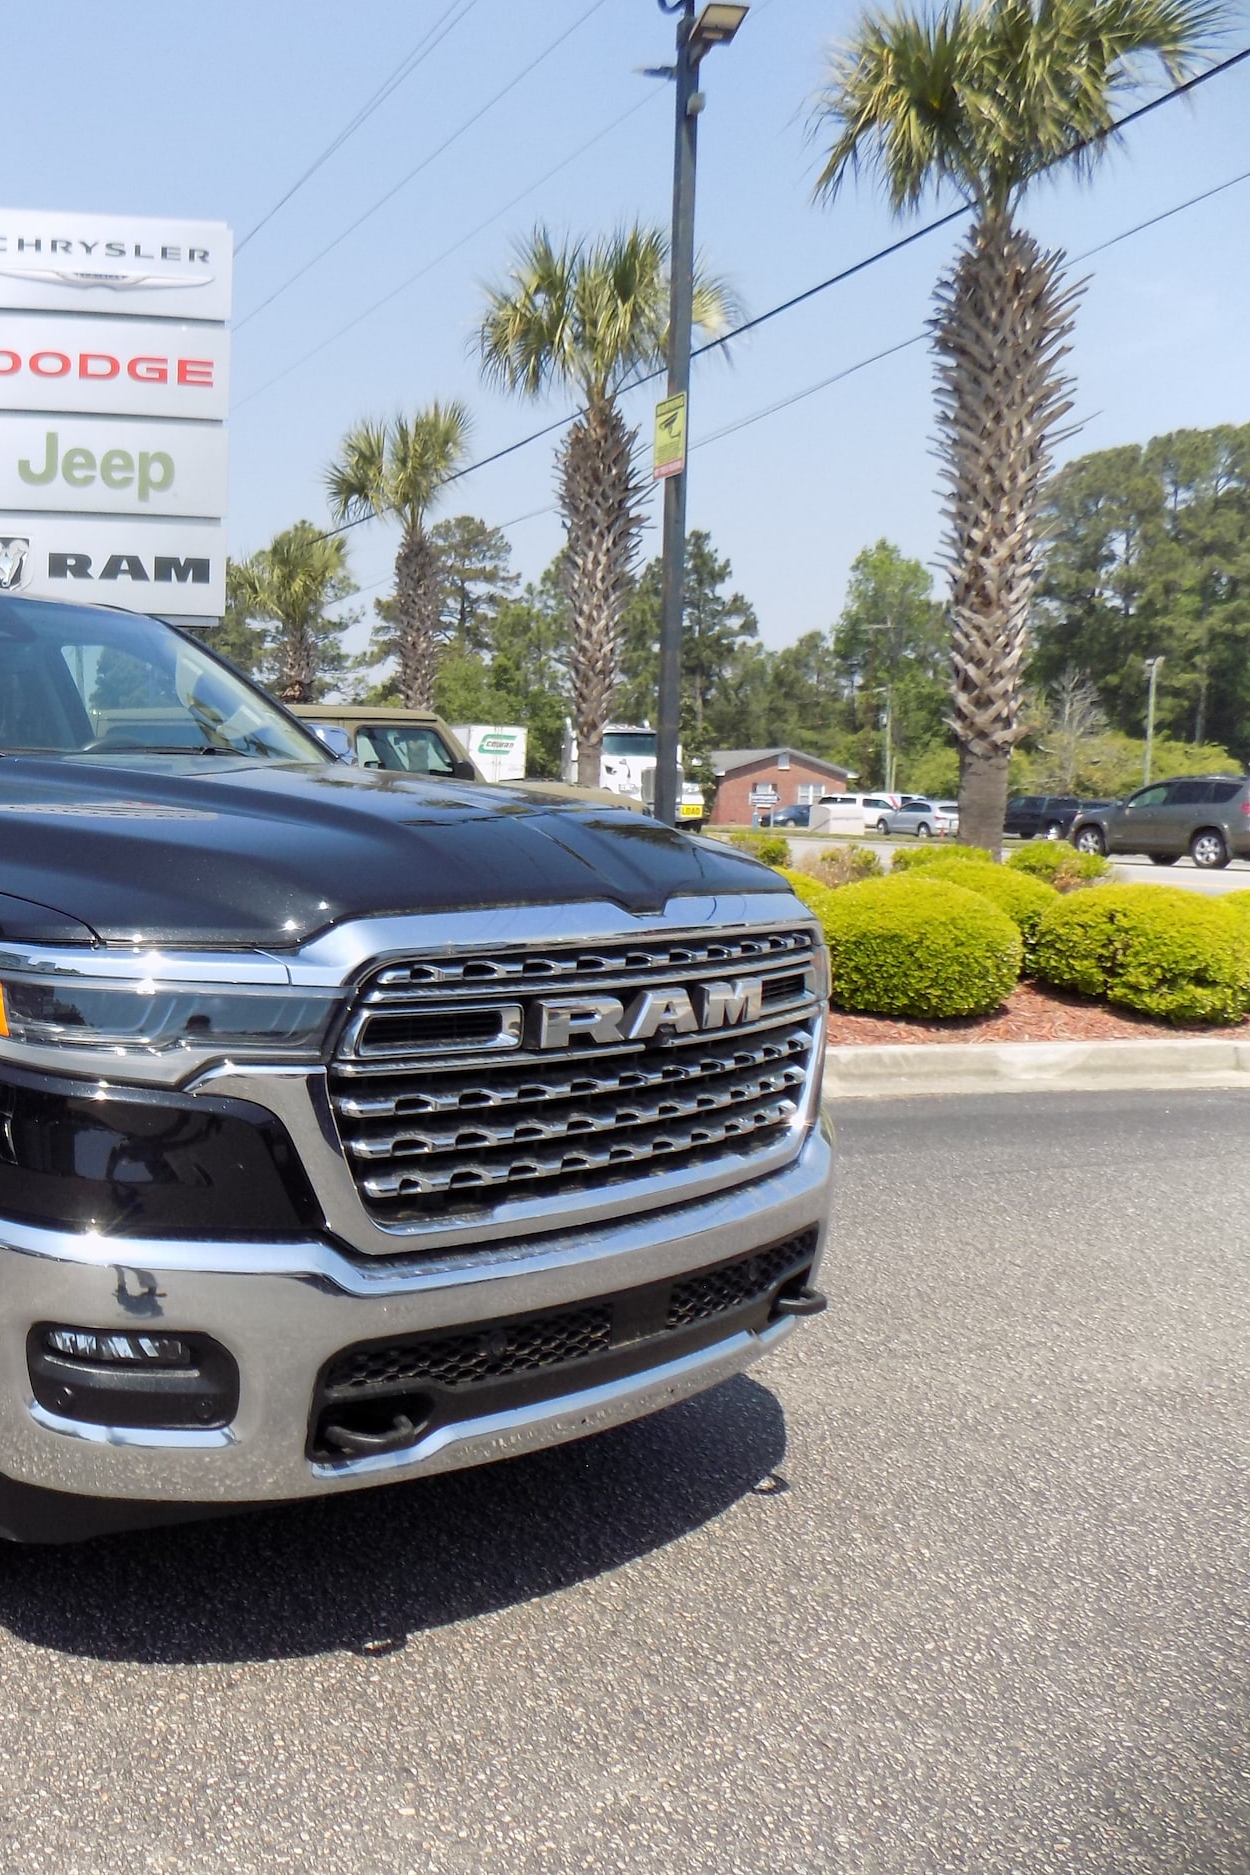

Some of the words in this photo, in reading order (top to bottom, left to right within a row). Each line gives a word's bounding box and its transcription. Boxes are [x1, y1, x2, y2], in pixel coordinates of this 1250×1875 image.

[18, 431, 176, 502] Jeep
[48, 552, 211, 585] RAM
[681, 806, 701, 816] LOAD
[535, 976, 763, 1049] RAM
